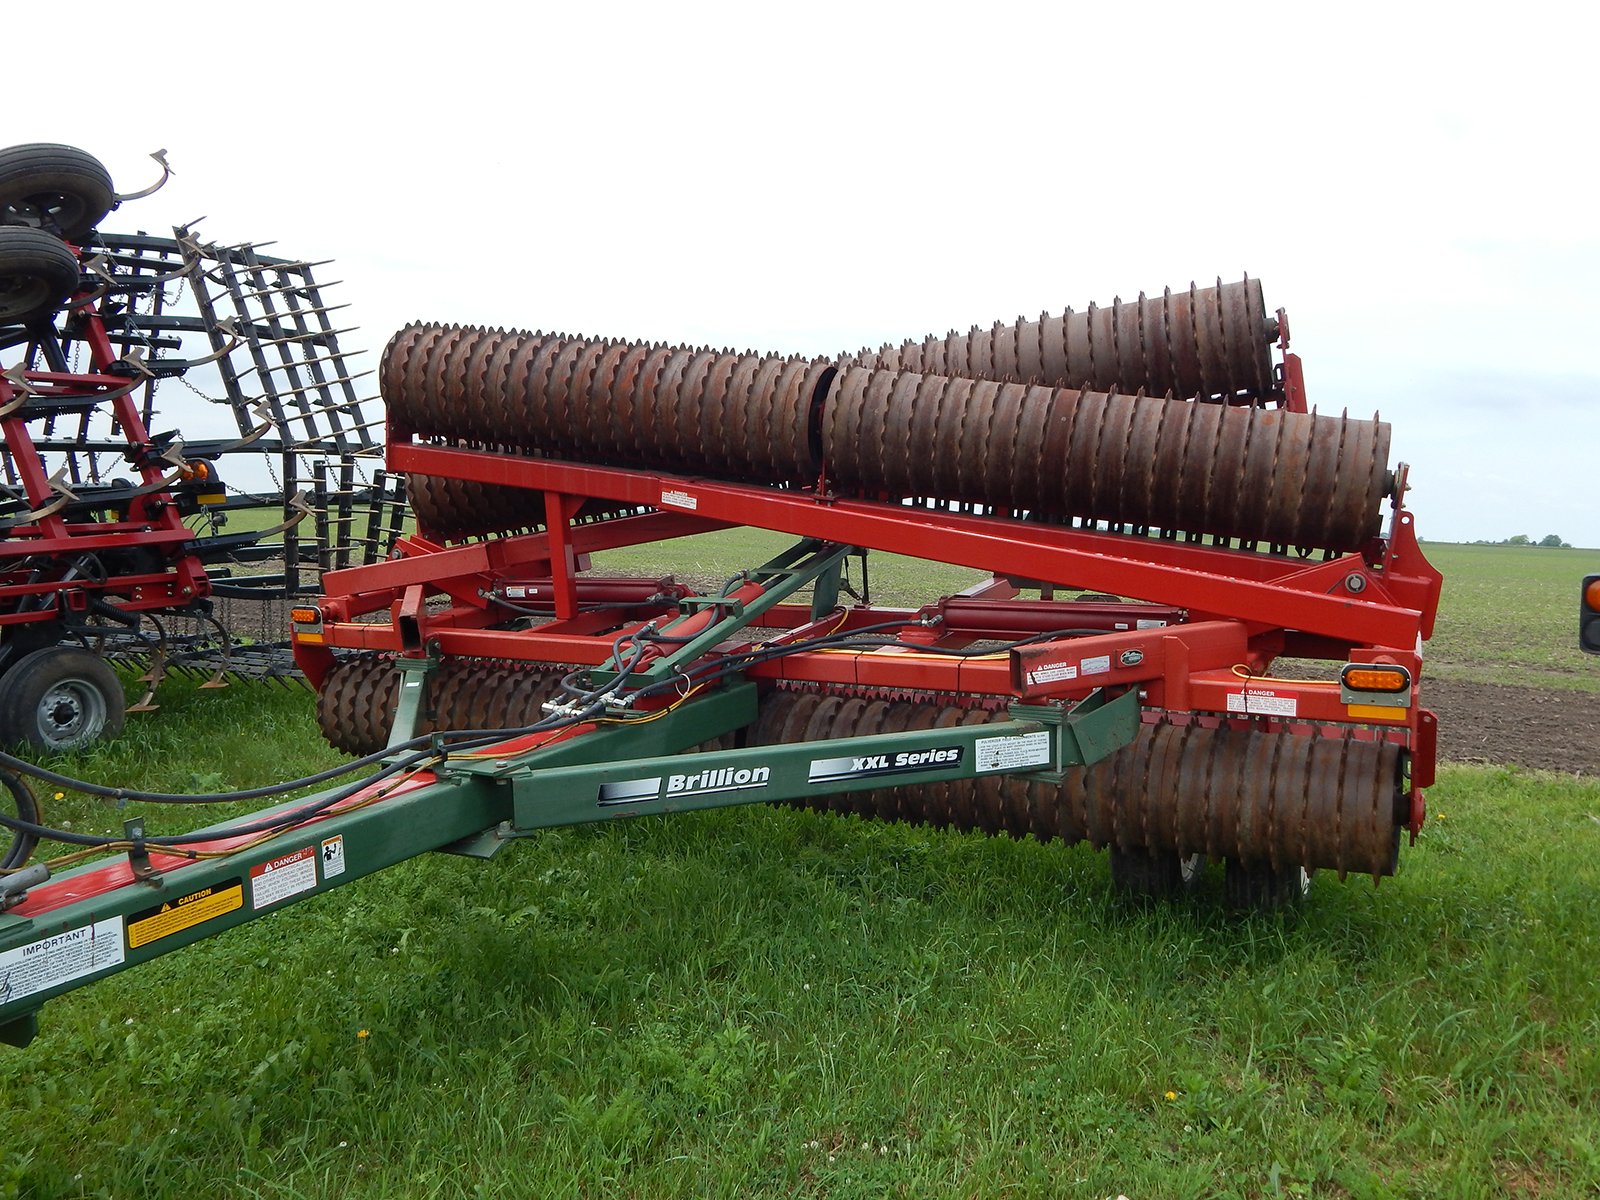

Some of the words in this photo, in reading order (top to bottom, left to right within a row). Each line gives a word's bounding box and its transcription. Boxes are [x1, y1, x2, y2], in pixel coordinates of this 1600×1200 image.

[1043, 662, 1067, 670] DANGER
[850, 756, 889, 771] XXL
[895, 748, 958, 767] Series
[666, 765, 771, 793] Brillion
[273, 852, 303, 868] DANGER
[178, 888, 212, 905] CAUTION
[22, 929, 86, 957] IMPORTANT
